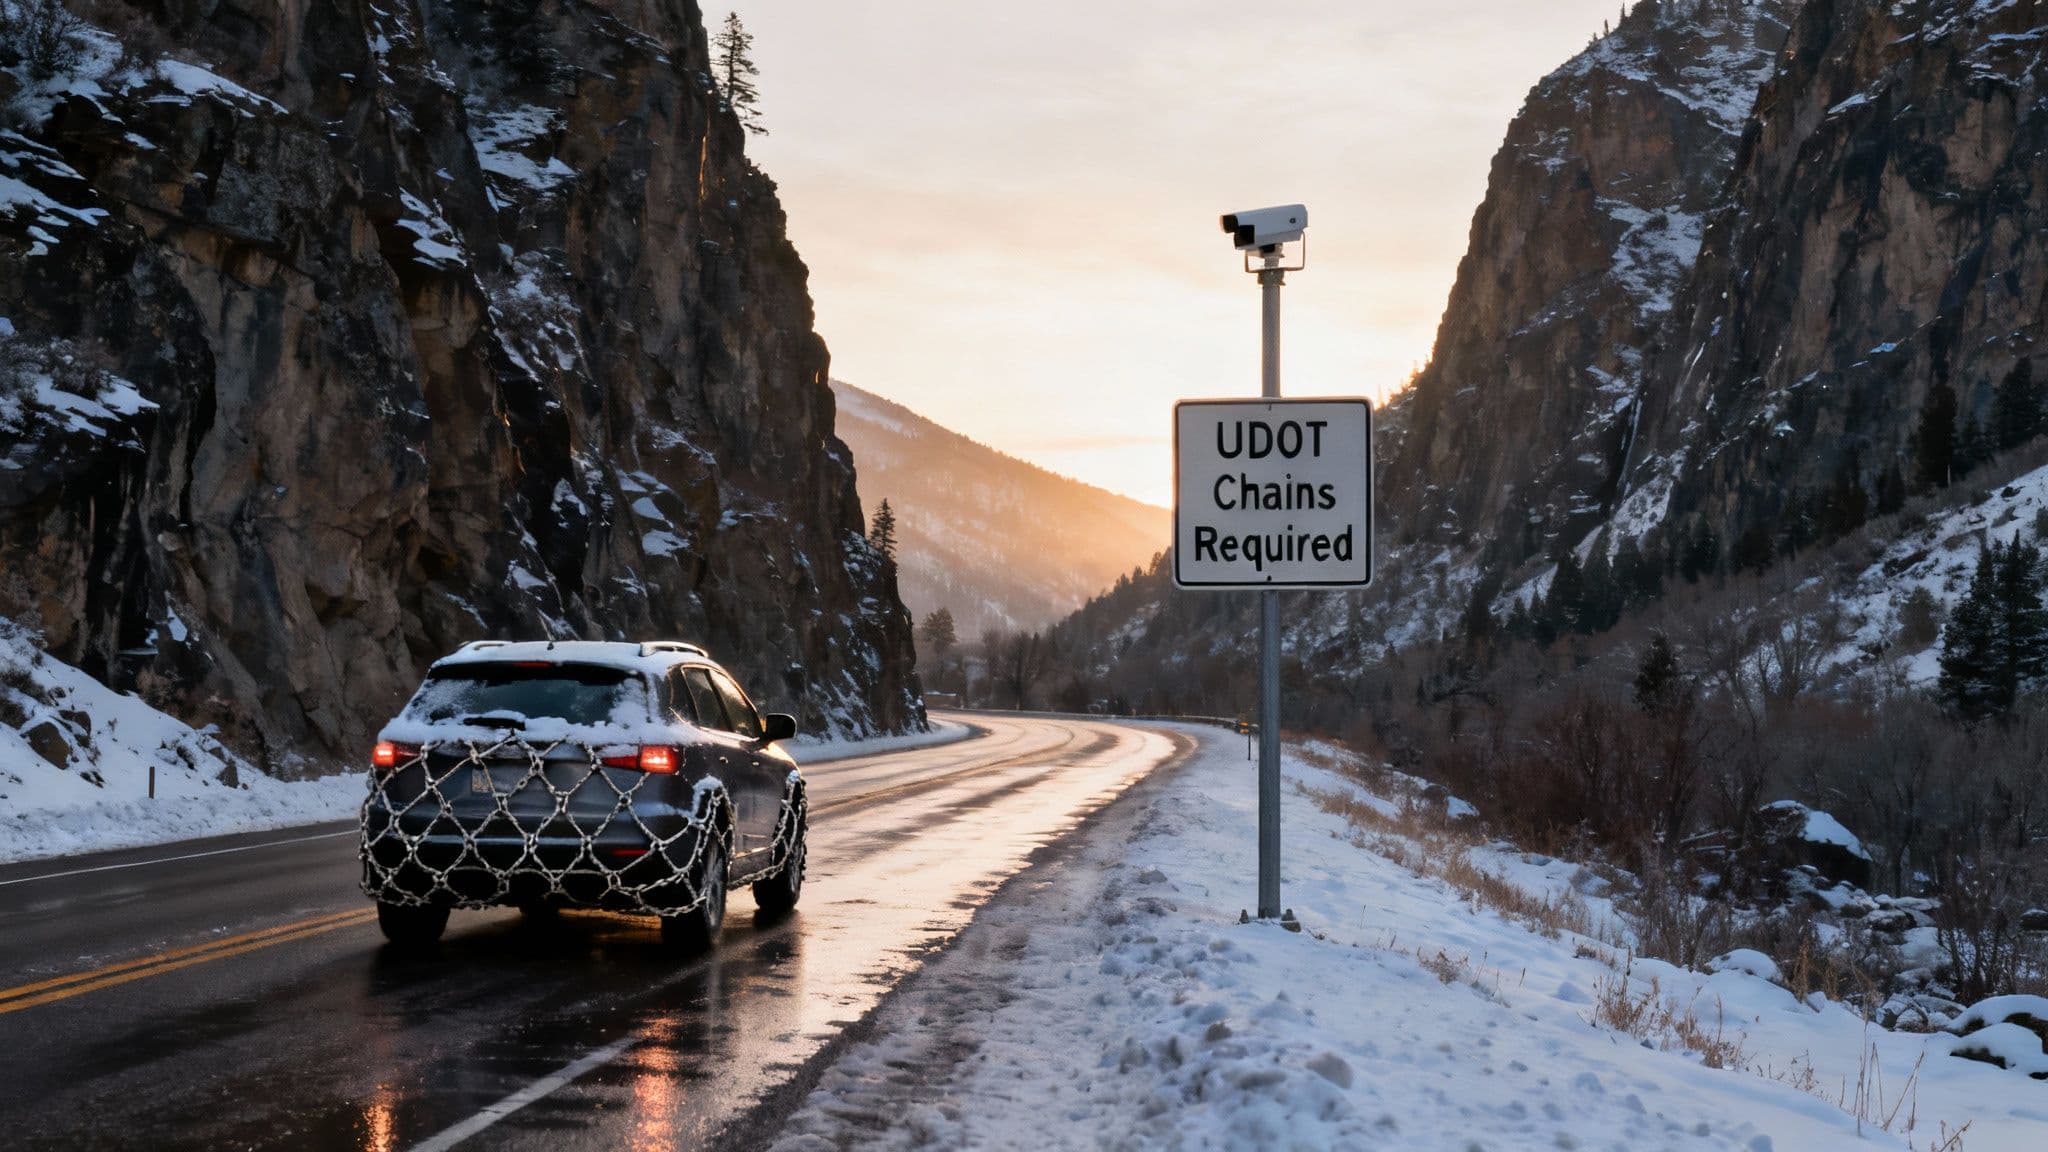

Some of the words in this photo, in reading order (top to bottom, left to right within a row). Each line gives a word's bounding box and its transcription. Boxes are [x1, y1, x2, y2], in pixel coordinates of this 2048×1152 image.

[1217, 419, 1328, 459] UDOT
[1213, 473, 1336, 511] Chains
[1195, 524, 1353, 572] Required
